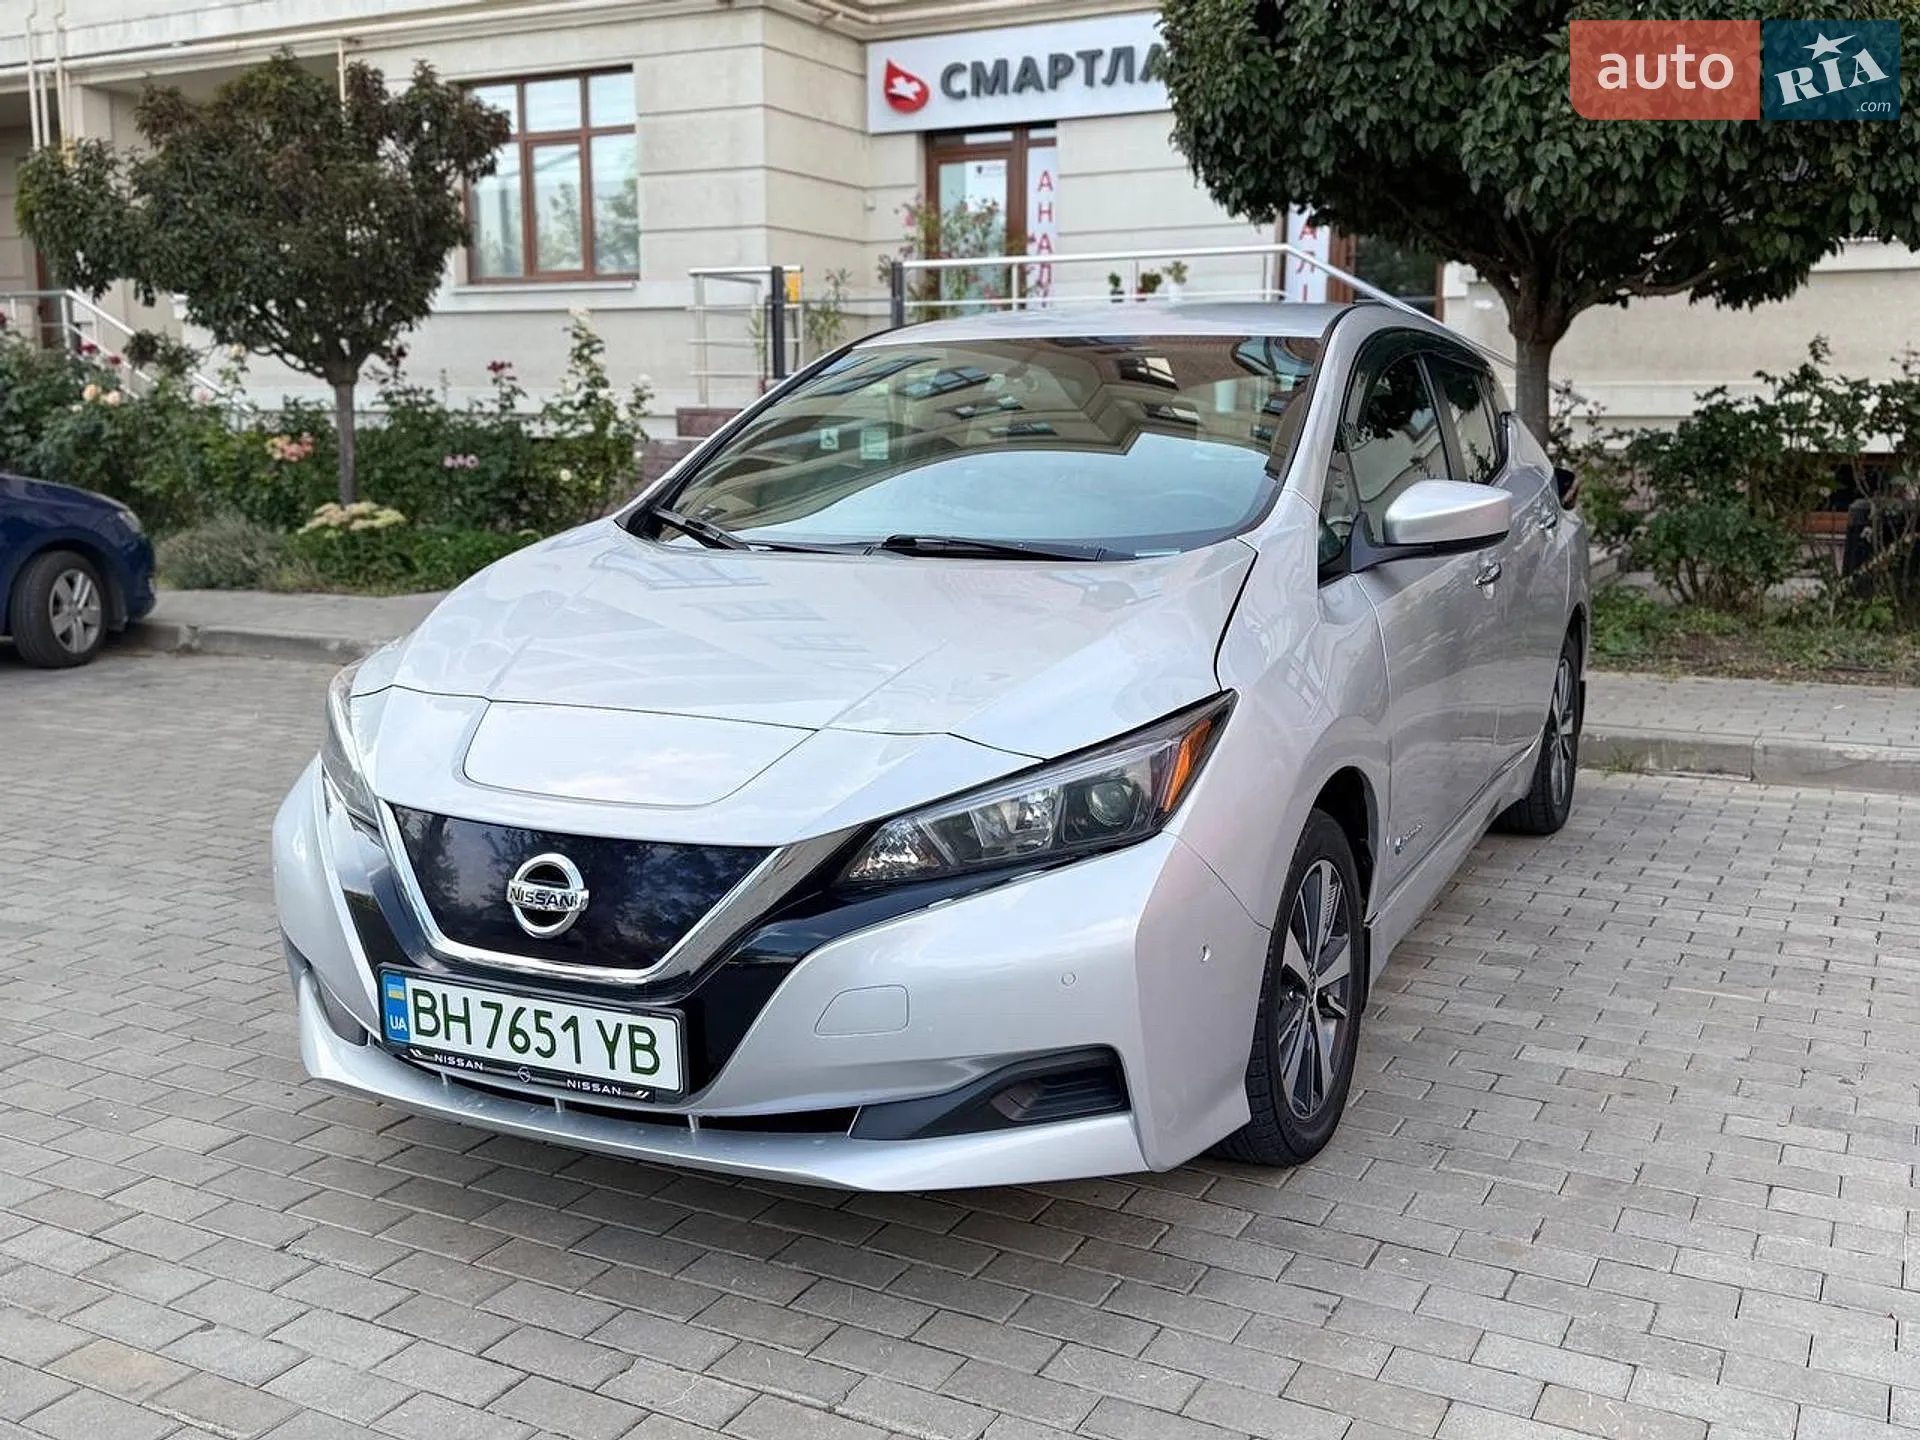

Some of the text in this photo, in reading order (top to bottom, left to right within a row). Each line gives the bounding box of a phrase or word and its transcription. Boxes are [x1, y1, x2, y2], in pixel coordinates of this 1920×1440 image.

[510, 886, 576, 908] NISSAN
[389, 1014, 408, 1032] UA
[434, 1053, 484, 1072] NISSAN
[566, 1079, 622, 1097] NISSAN
